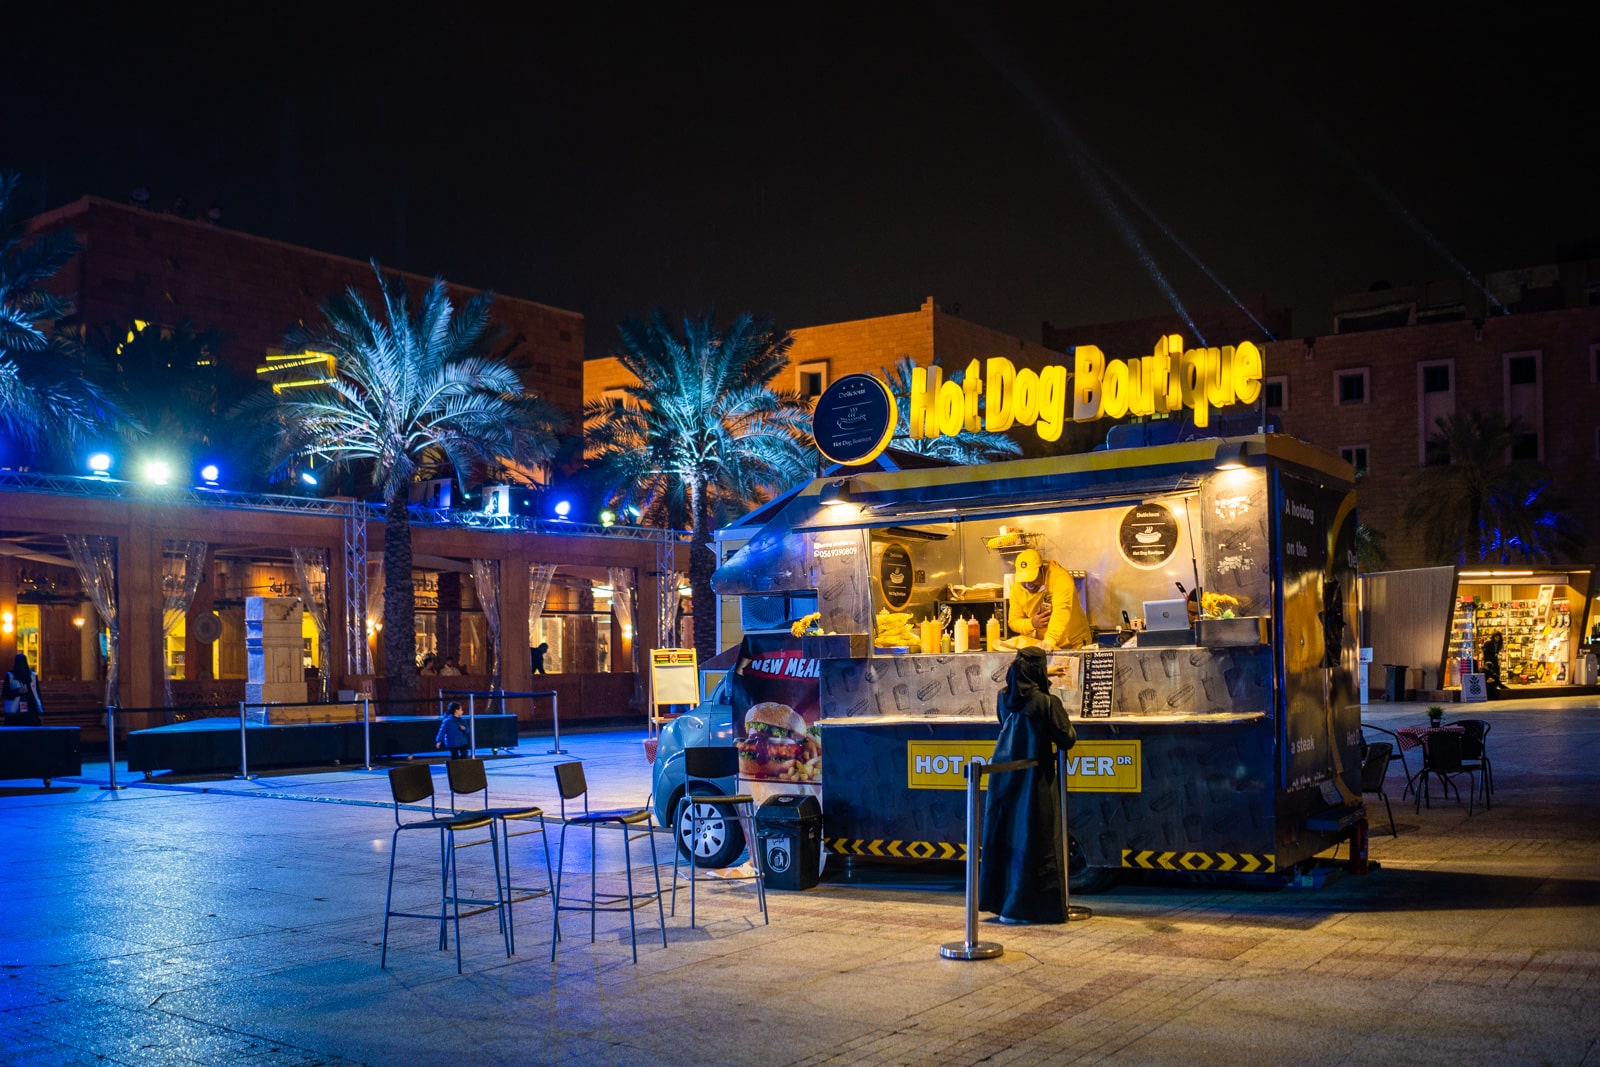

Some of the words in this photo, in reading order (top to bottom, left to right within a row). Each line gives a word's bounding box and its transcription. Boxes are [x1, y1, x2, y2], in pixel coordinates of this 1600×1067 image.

[909, 357, 983, 440] Hot
[985, 356, 1067, 442] Dog
[1073, 333, 1263, 428] Boutique
[1285, 498, 1291, 515] A
[1291, 500, 1315, 526] hotdog
[1286, 541, 1295, 556] on
[1296, 540, 1308, 557] the
[751, 658, 784, 675] NEW
[1290, 741, 1296, 756] a
[1296, 734, 1315, 753] steak
[915, 754, 964, 774] HOT
[1066, 756, 1115, 776] VER
[1117, 756, 1132, 765] DR
